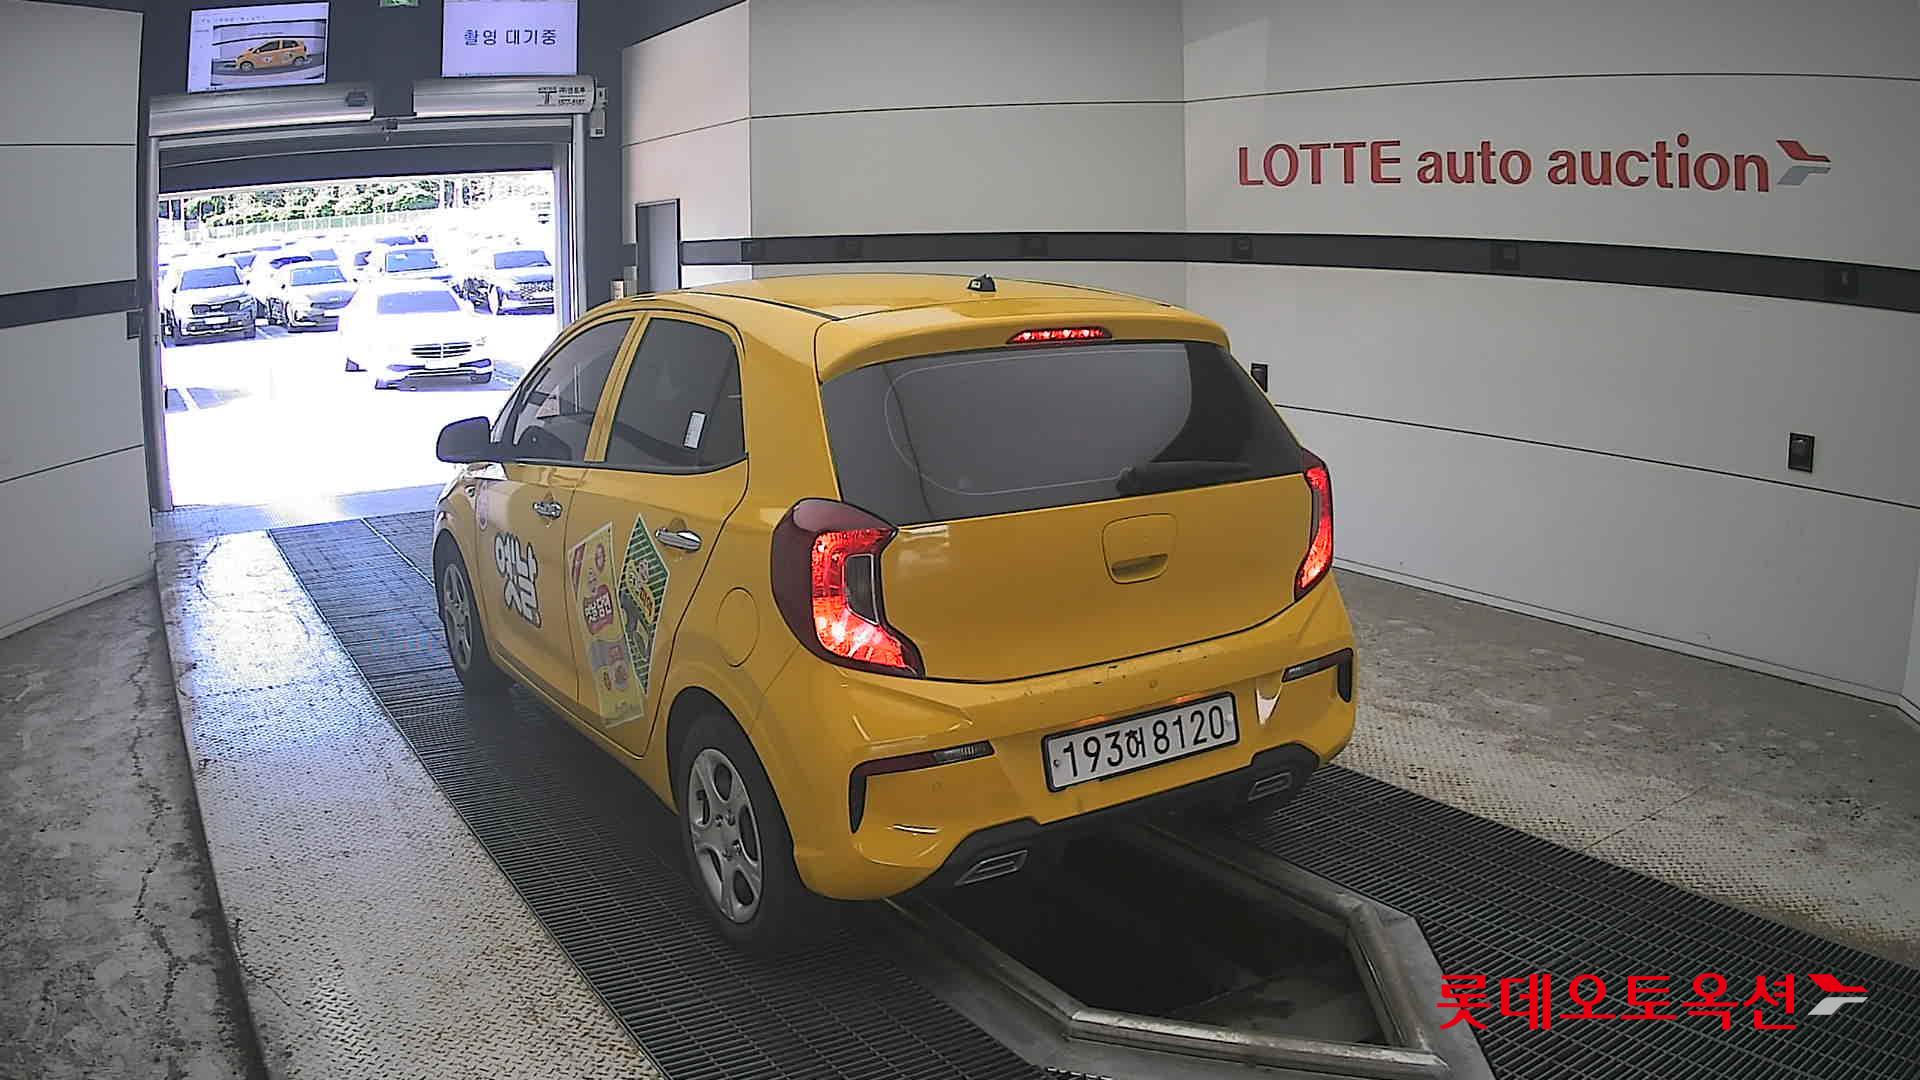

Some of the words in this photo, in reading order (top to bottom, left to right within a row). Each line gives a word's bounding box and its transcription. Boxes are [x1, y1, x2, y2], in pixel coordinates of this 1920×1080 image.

[464, 28, 497, 46] 촬영
[505, 28, 557, 46] 대기중
[1238, 139, 1401, 187] LOTTE
[1416, 140, 1533, 186] auto
[1546, 132, 1770, 193] auction
